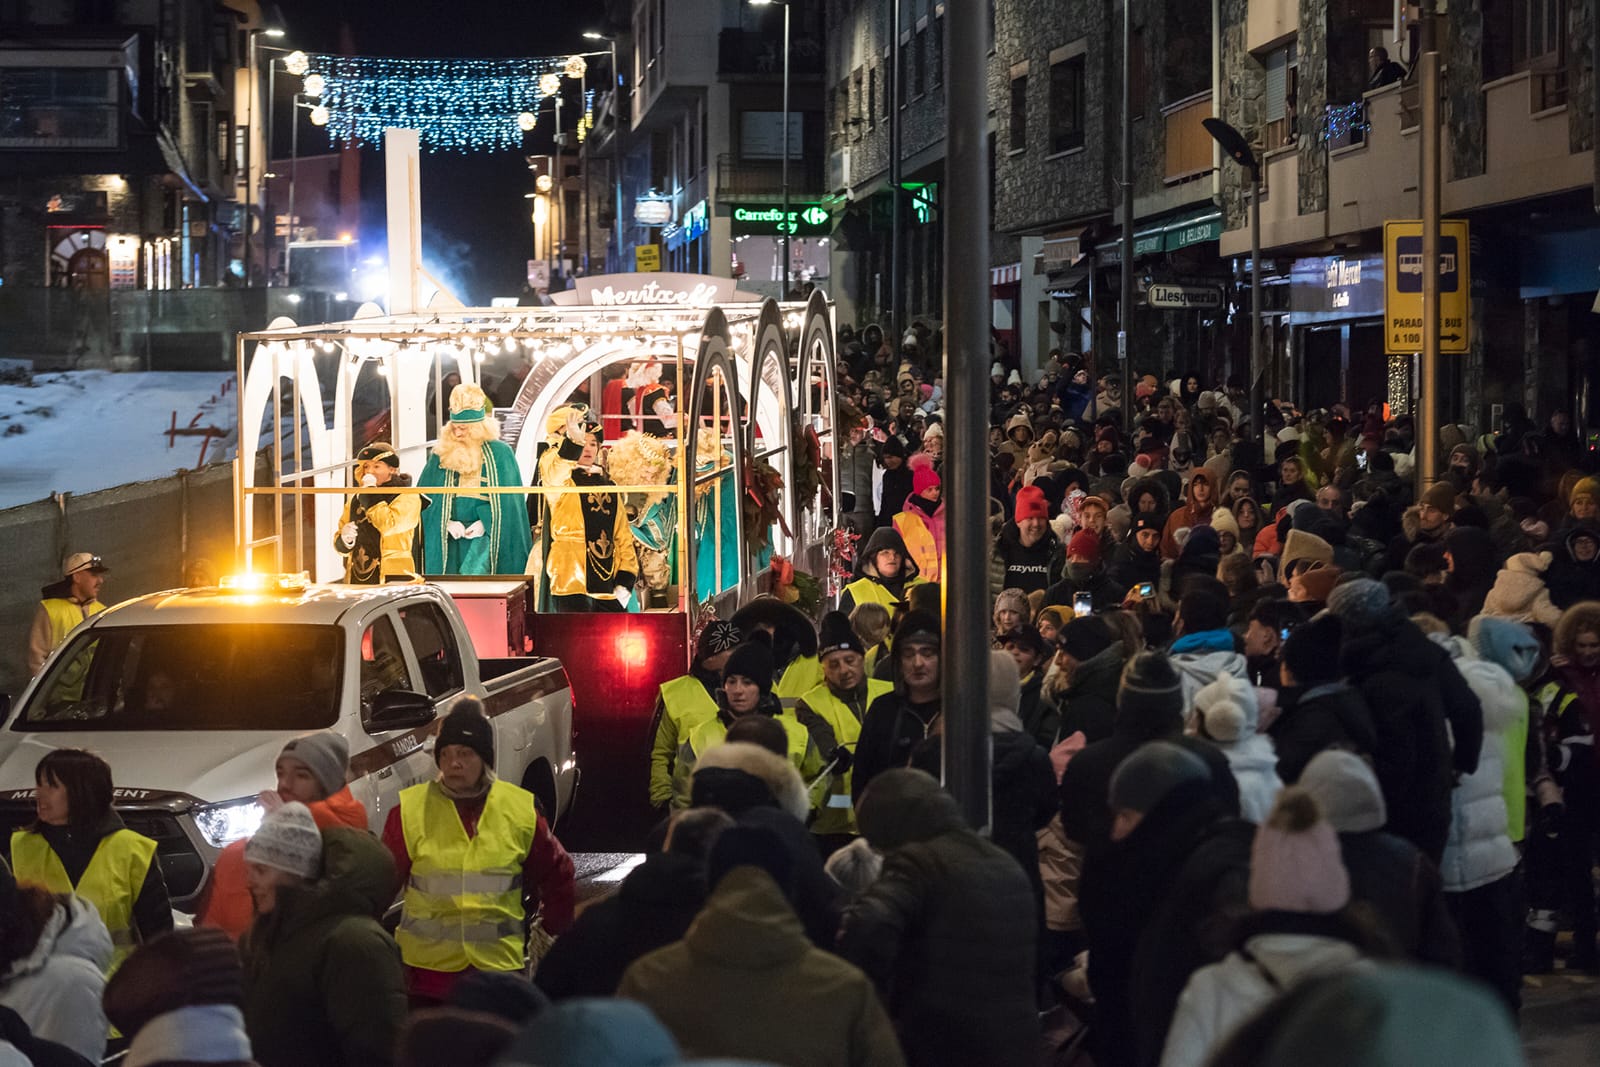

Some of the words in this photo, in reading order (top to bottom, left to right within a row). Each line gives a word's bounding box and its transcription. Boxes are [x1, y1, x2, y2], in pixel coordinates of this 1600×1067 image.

[590, 280, 718, 305] Meritxell
[1155, 288, 1218, 306] Llesqueria
[1393, 318, 1423, 328] PARAD
[1445, 318, 1463, 328] BUS
[1394, 334, 1400, 343] A
[1403, 333, 1420, 343] 100
